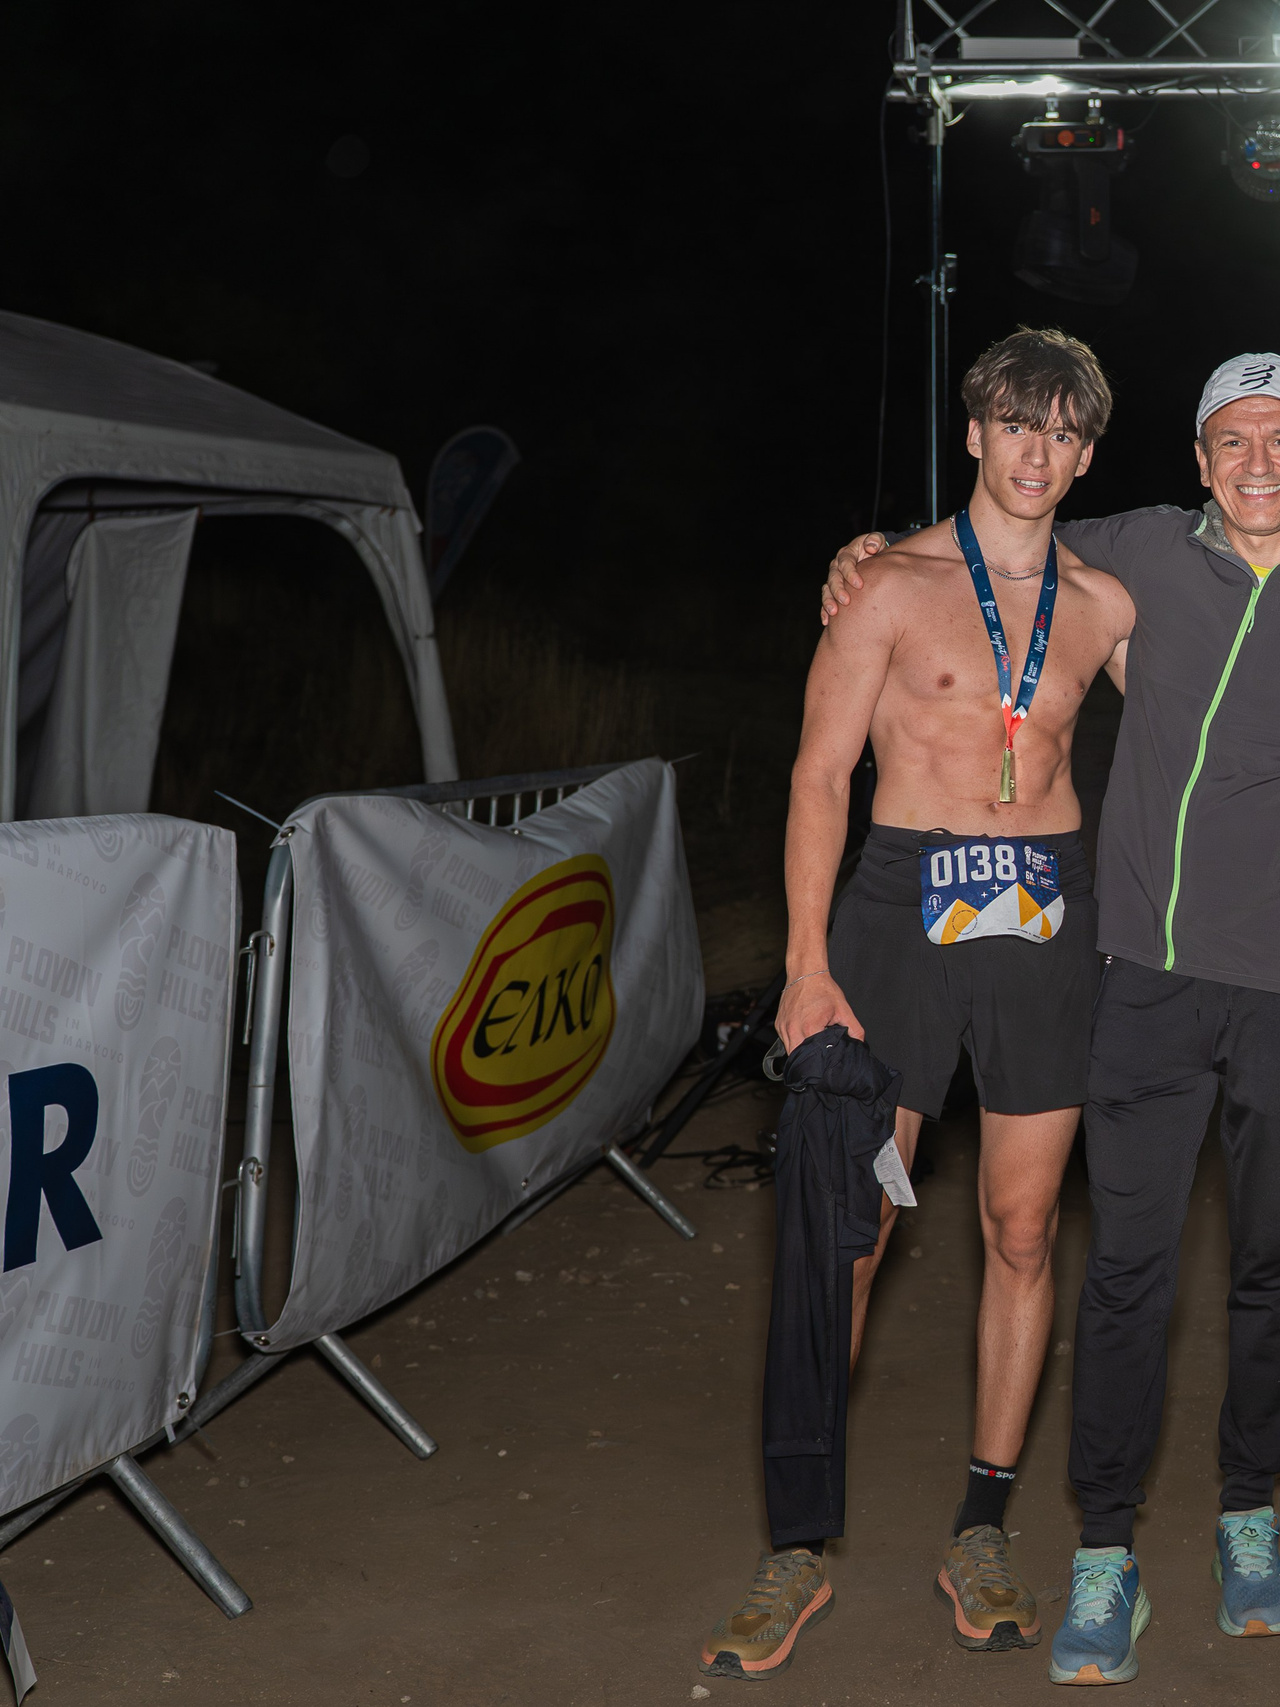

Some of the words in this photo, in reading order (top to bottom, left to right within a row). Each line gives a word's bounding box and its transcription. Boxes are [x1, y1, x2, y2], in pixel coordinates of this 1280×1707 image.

[46, 858, 107, 895] MARKOVO
[930, 844, 1018, 888] 0138
[6, 935, 103, 1008] PLOVDIV
[156, 969, 214, 1024] HILLS
[0, 986, 59, 1045] HILLS
[62, 1033, 124, 1064] MARKOVO
[3, 1061, 104, 1274] R
[27, 1290, 128, 1343] PLOVDIV
[12, 1341, 85, 1389] HILLS
